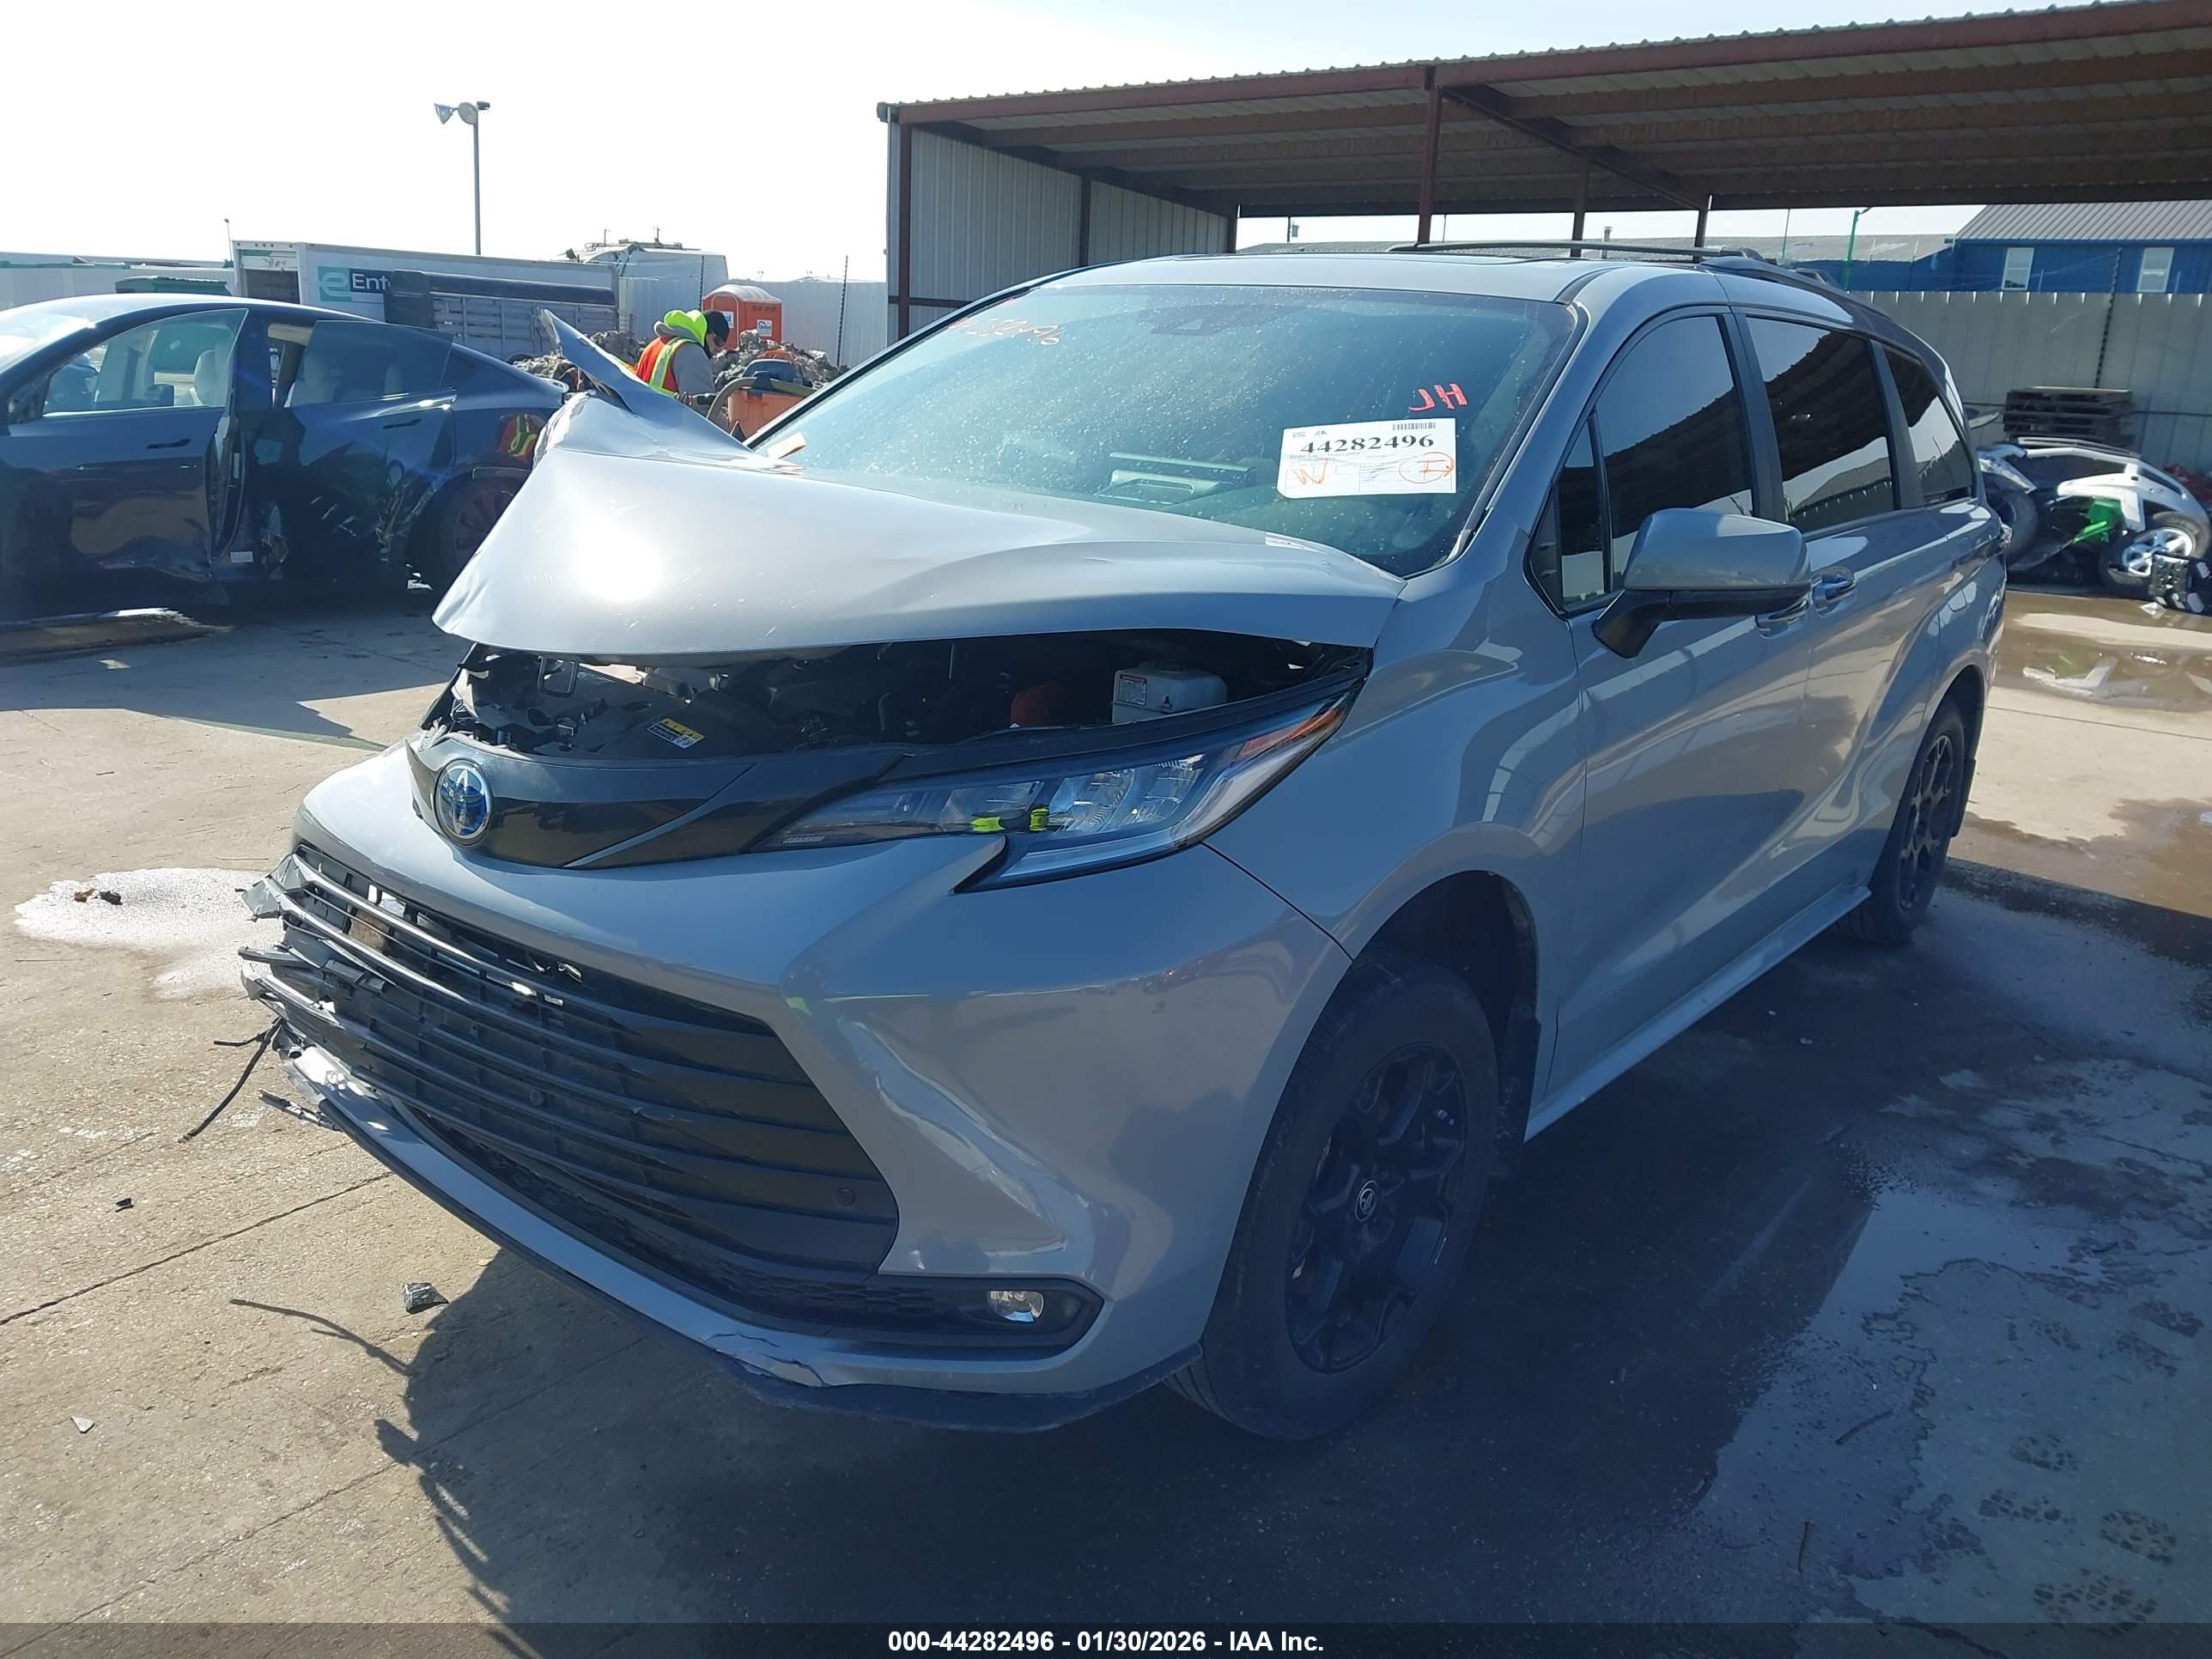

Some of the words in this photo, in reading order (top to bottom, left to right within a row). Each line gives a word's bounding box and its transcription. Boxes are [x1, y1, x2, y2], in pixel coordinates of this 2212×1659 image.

[352, 272, 392, 290] Ent
[1407, 383, 1468, 411] JH
[1301, 434, 1435, 453] 44282496
